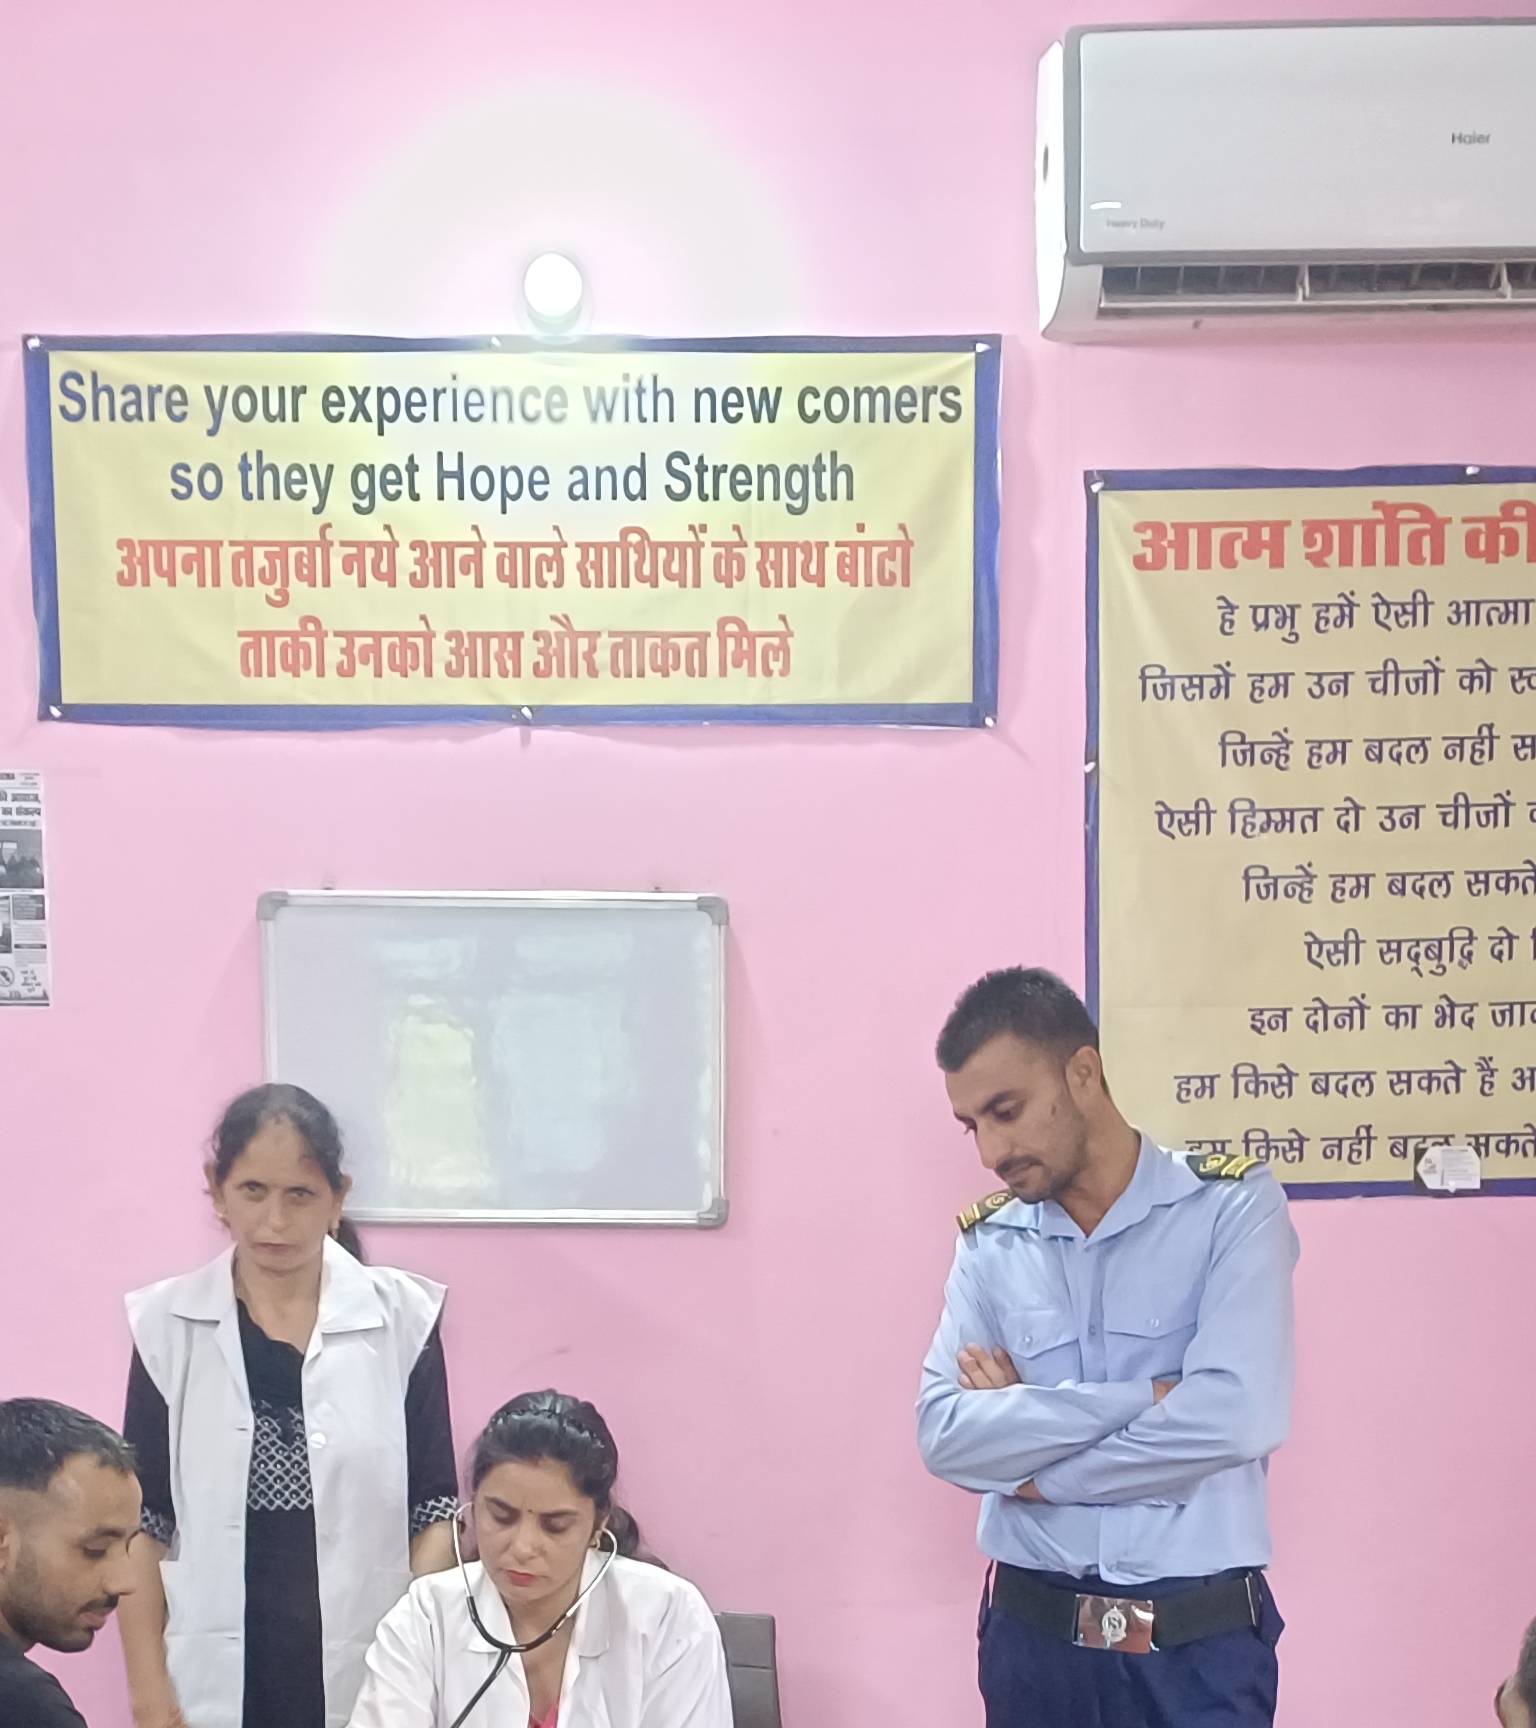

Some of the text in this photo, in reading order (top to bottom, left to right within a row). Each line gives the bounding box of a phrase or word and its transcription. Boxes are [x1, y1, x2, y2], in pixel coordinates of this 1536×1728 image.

[1450, 131, 1492, 145] Haier
[59, 370, 962, 437] Share your experience with new comers
[171, 449, 853, 515] so they get Hope and Strength
[116, 523, 914, 608] अपना तजुर्बा नये आने वाले साथियों के साथ बांटो
[1133, 520, 1292, 571] आत्म
[1216, 595, 1239, 636] हे
[1249, 604, 1301, 644] प्रभु
[1312, 590, 1360, 634] हमें
[1371, 589, 1435, 632] ऐसी
[1447, 599, 1536, 626] आत्मा
[237, 614, 794, 679] ताकी उनको आस और ताकत मिले
[1139, 661, 1236, 702] जिसमें
[1247, 672, 1295, 704] हम
[1305, 672, 1355, 699] उन
[1365, 656, 1445, 696] चीजों
[1456, 658, 1498, 694] को
[1218, 727, 1294, 771] जिन्हें
[1305, 739, 1353, 769] हम
[1363, 737, 1432, 766] बदल
[1442, 723, 1500, 766] नहीं
[1155, 798, 1217, 840] ऐसी
[1228, 798, 1324, 838] हिम्मत
[1334, 796, 1366, 834] दो
[1376, 805, 1426, 832] उन
[1436, 790, 1516, 830] चीजों
[1242, 861, 1318, 904] जिन्हें
[1329, 873, 1376, 903] हम
[1386, 871, 1454, 899] बदल
[1304, 928, 1366, 970] ऐसी
[1488, 926, 1519, 963] दो
[1248, 1007, 1293, 1035] इन
[1303, 993, 1371, 1034] दोनों
[1382, 1004, 1423, 1030] का
[1435, 994, 1479, 1030] भेद
[1174, 1074, 1221, 1104] हम
[1231, 1063, 1299, 1099] किसे
[1309, 1071, 1377, 1098] बदल
[1387, 1059, 1467, 1096] सकते
[1475, 1056, 1498, 1097] हैं
[1242, 1128, 1310, 1165] किसे
[1320, 1124, 1378, 1165] नहीं
